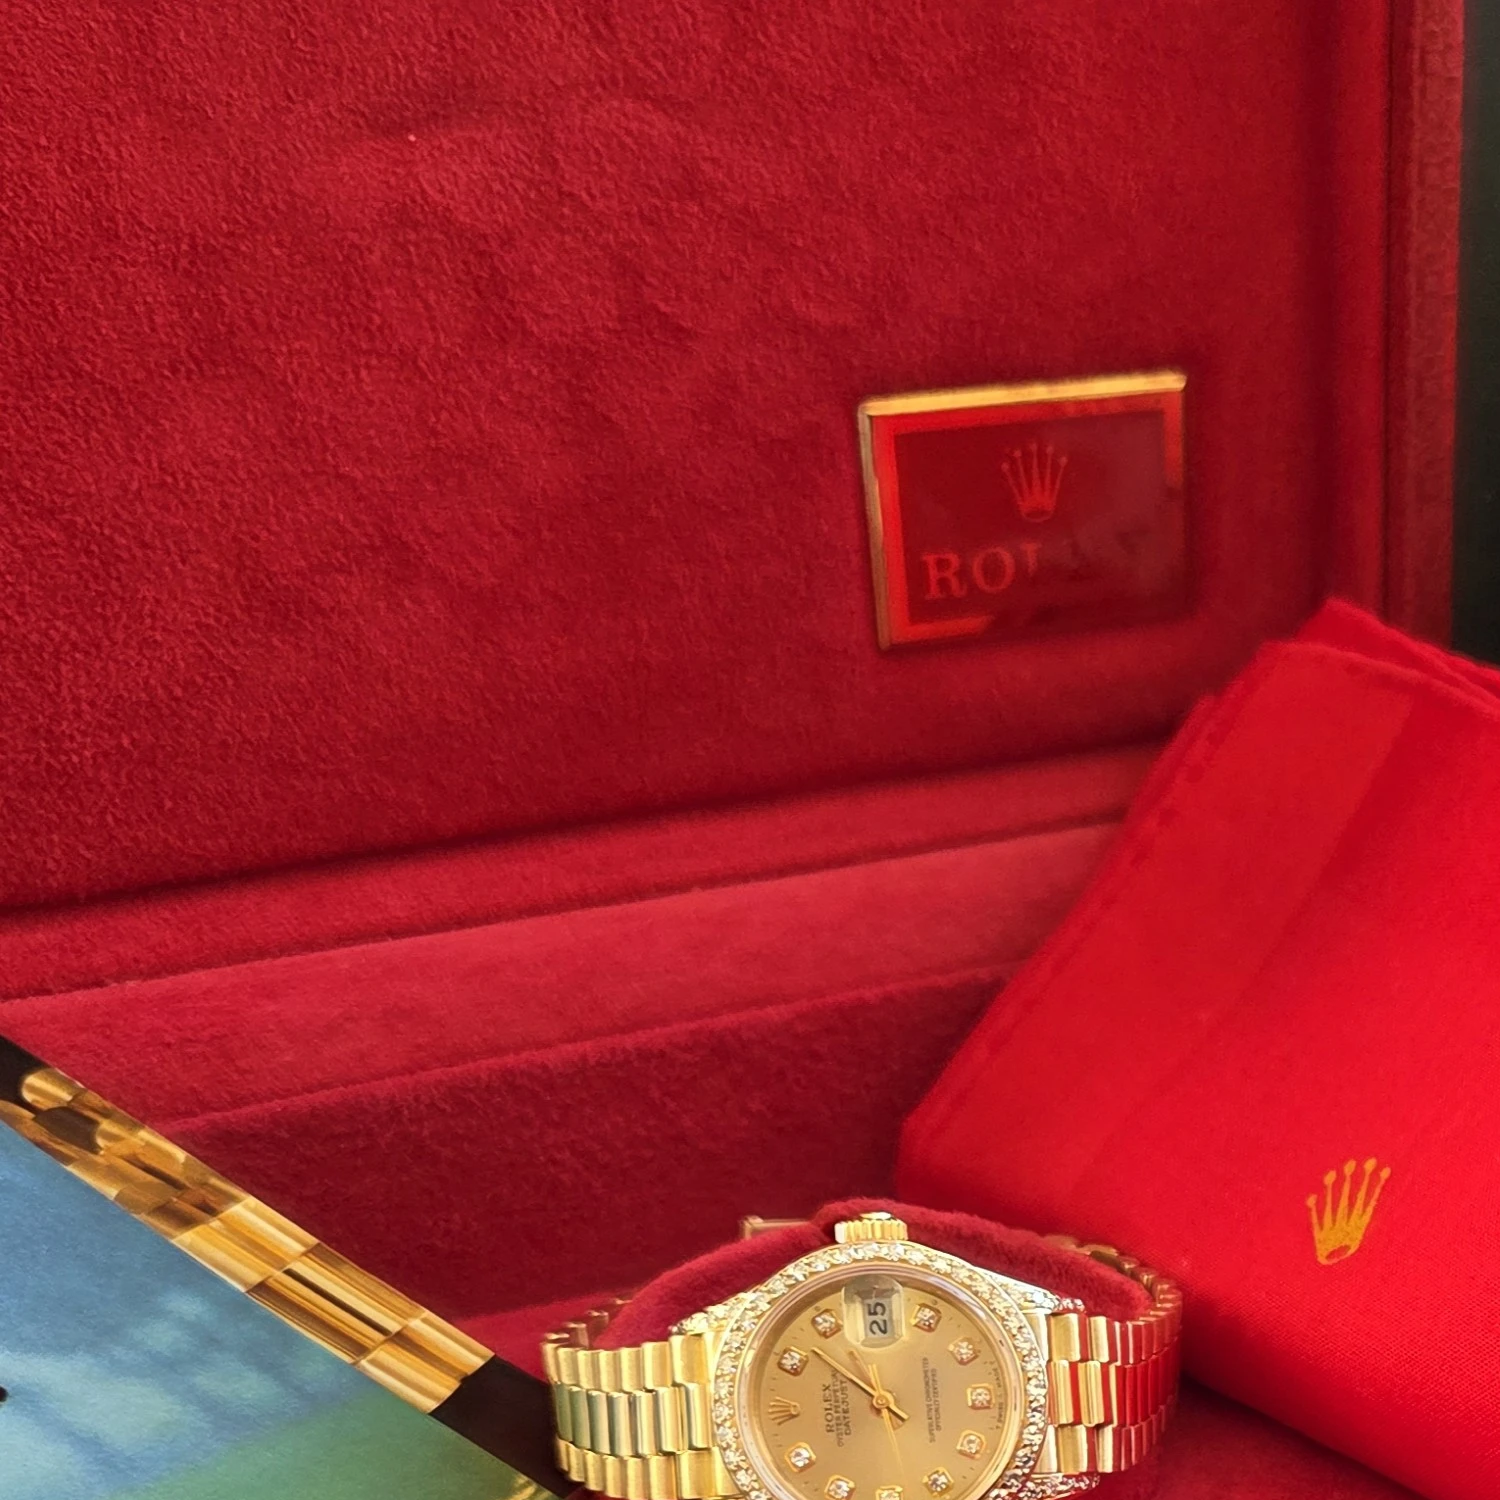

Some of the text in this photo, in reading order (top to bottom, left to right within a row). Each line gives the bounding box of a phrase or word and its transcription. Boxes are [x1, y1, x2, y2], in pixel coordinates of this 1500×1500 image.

[869, 1301, 888, 1335] 25
[822, 1383, 835, 1434] ROLEX
[831, 1368, 845, 1448] OYSTER PERPETUA
[839, 1379, 852, 1436] DATEJUST
